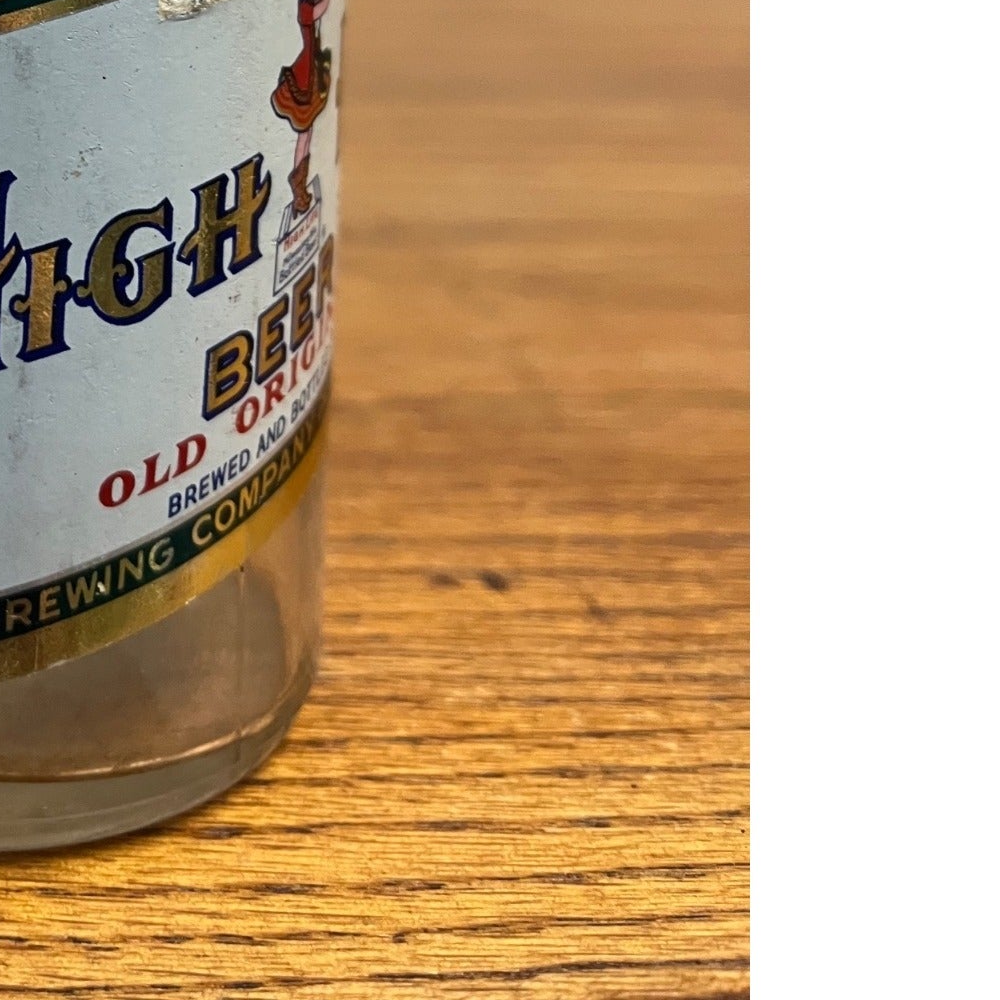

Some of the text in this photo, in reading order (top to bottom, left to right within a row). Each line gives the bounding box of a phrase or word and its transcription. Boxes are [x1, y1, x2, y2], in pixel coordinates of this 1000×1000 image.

[98, 433, 207, 508] OLD
[168, 448, 251, 518] BREWED
[256, 415, 286, 459] AND
